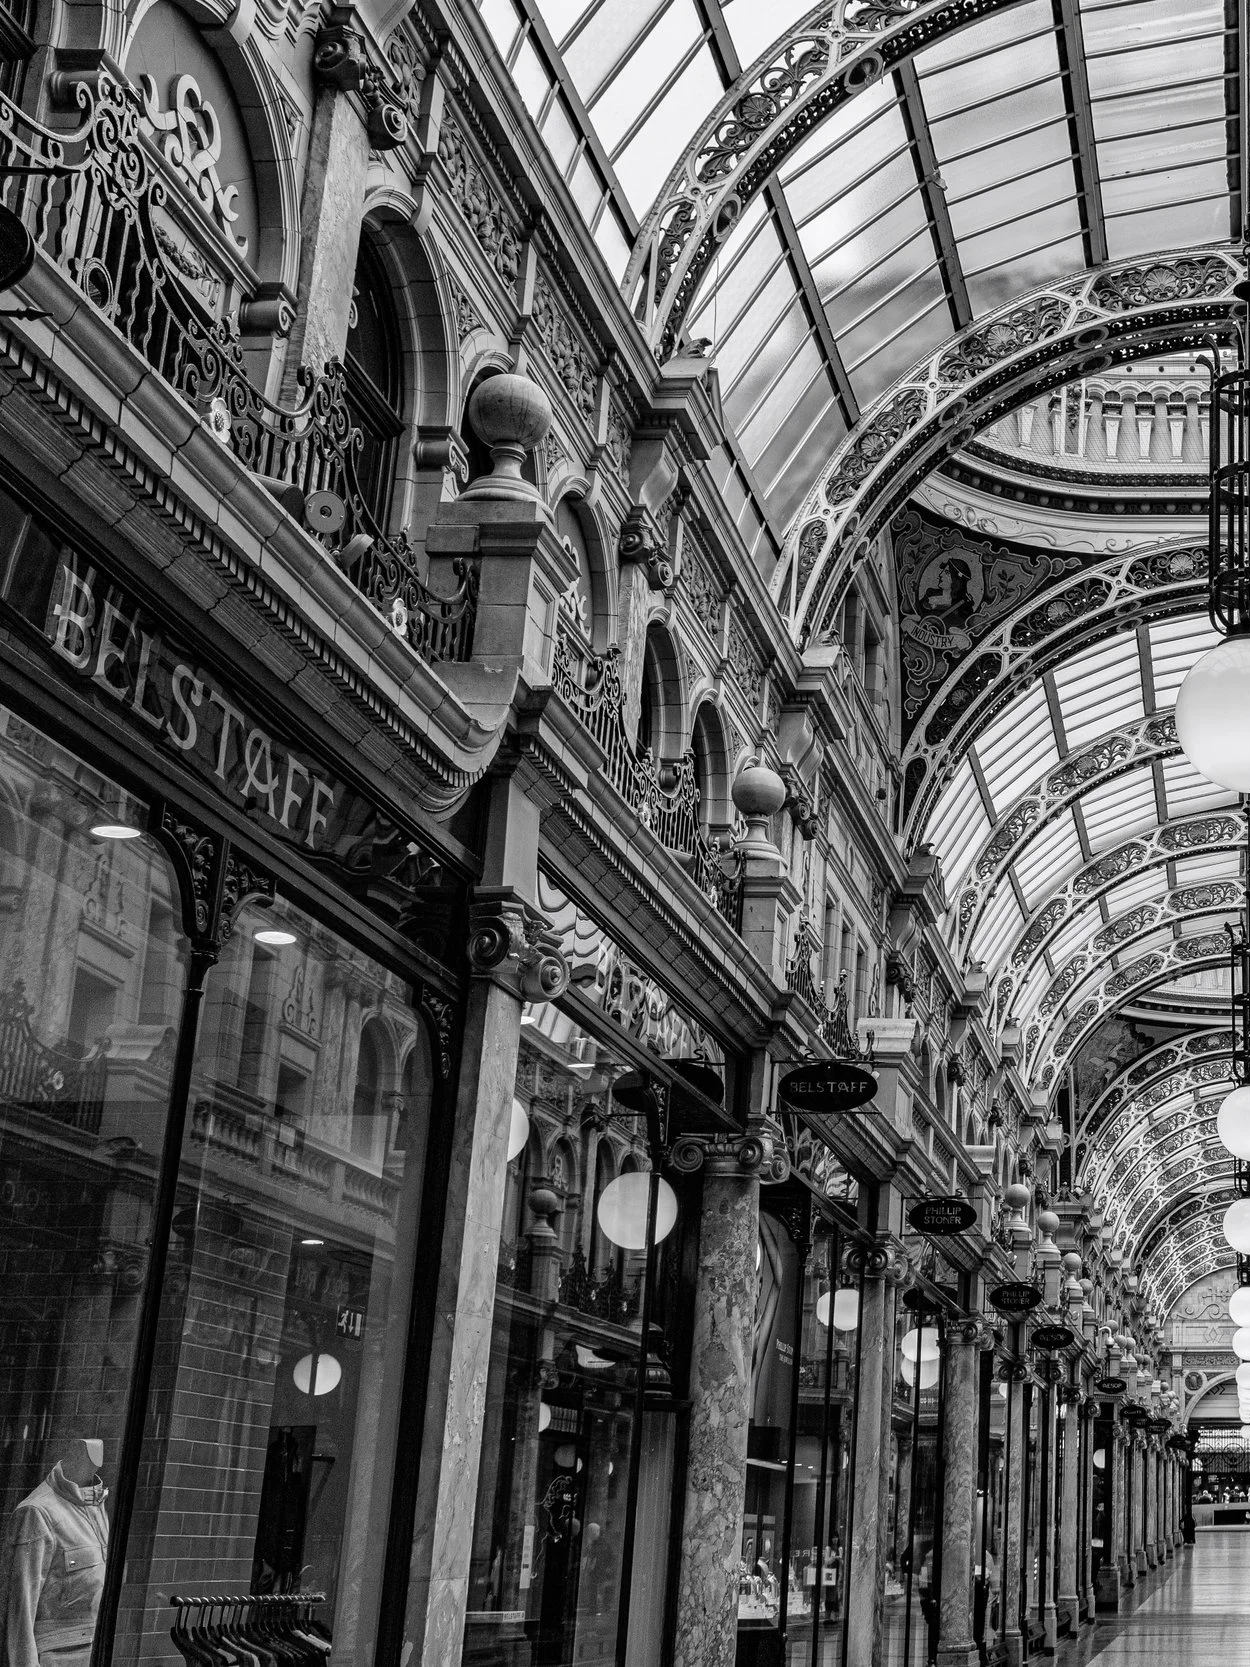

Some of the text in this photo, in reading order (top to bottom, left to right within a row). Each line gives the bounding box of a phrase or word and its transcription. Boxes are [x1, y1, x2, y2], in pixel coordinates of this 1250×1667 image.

[910, 625, 954, 648] INDUSTRY
[51, 564, 334, 849] BELSTAFF
[789, 1081, 868, 1093] BELSTAFF
[925, 1206, 962, 1215] PHILLIP
[924, 1216, 962, 1225] STONER
